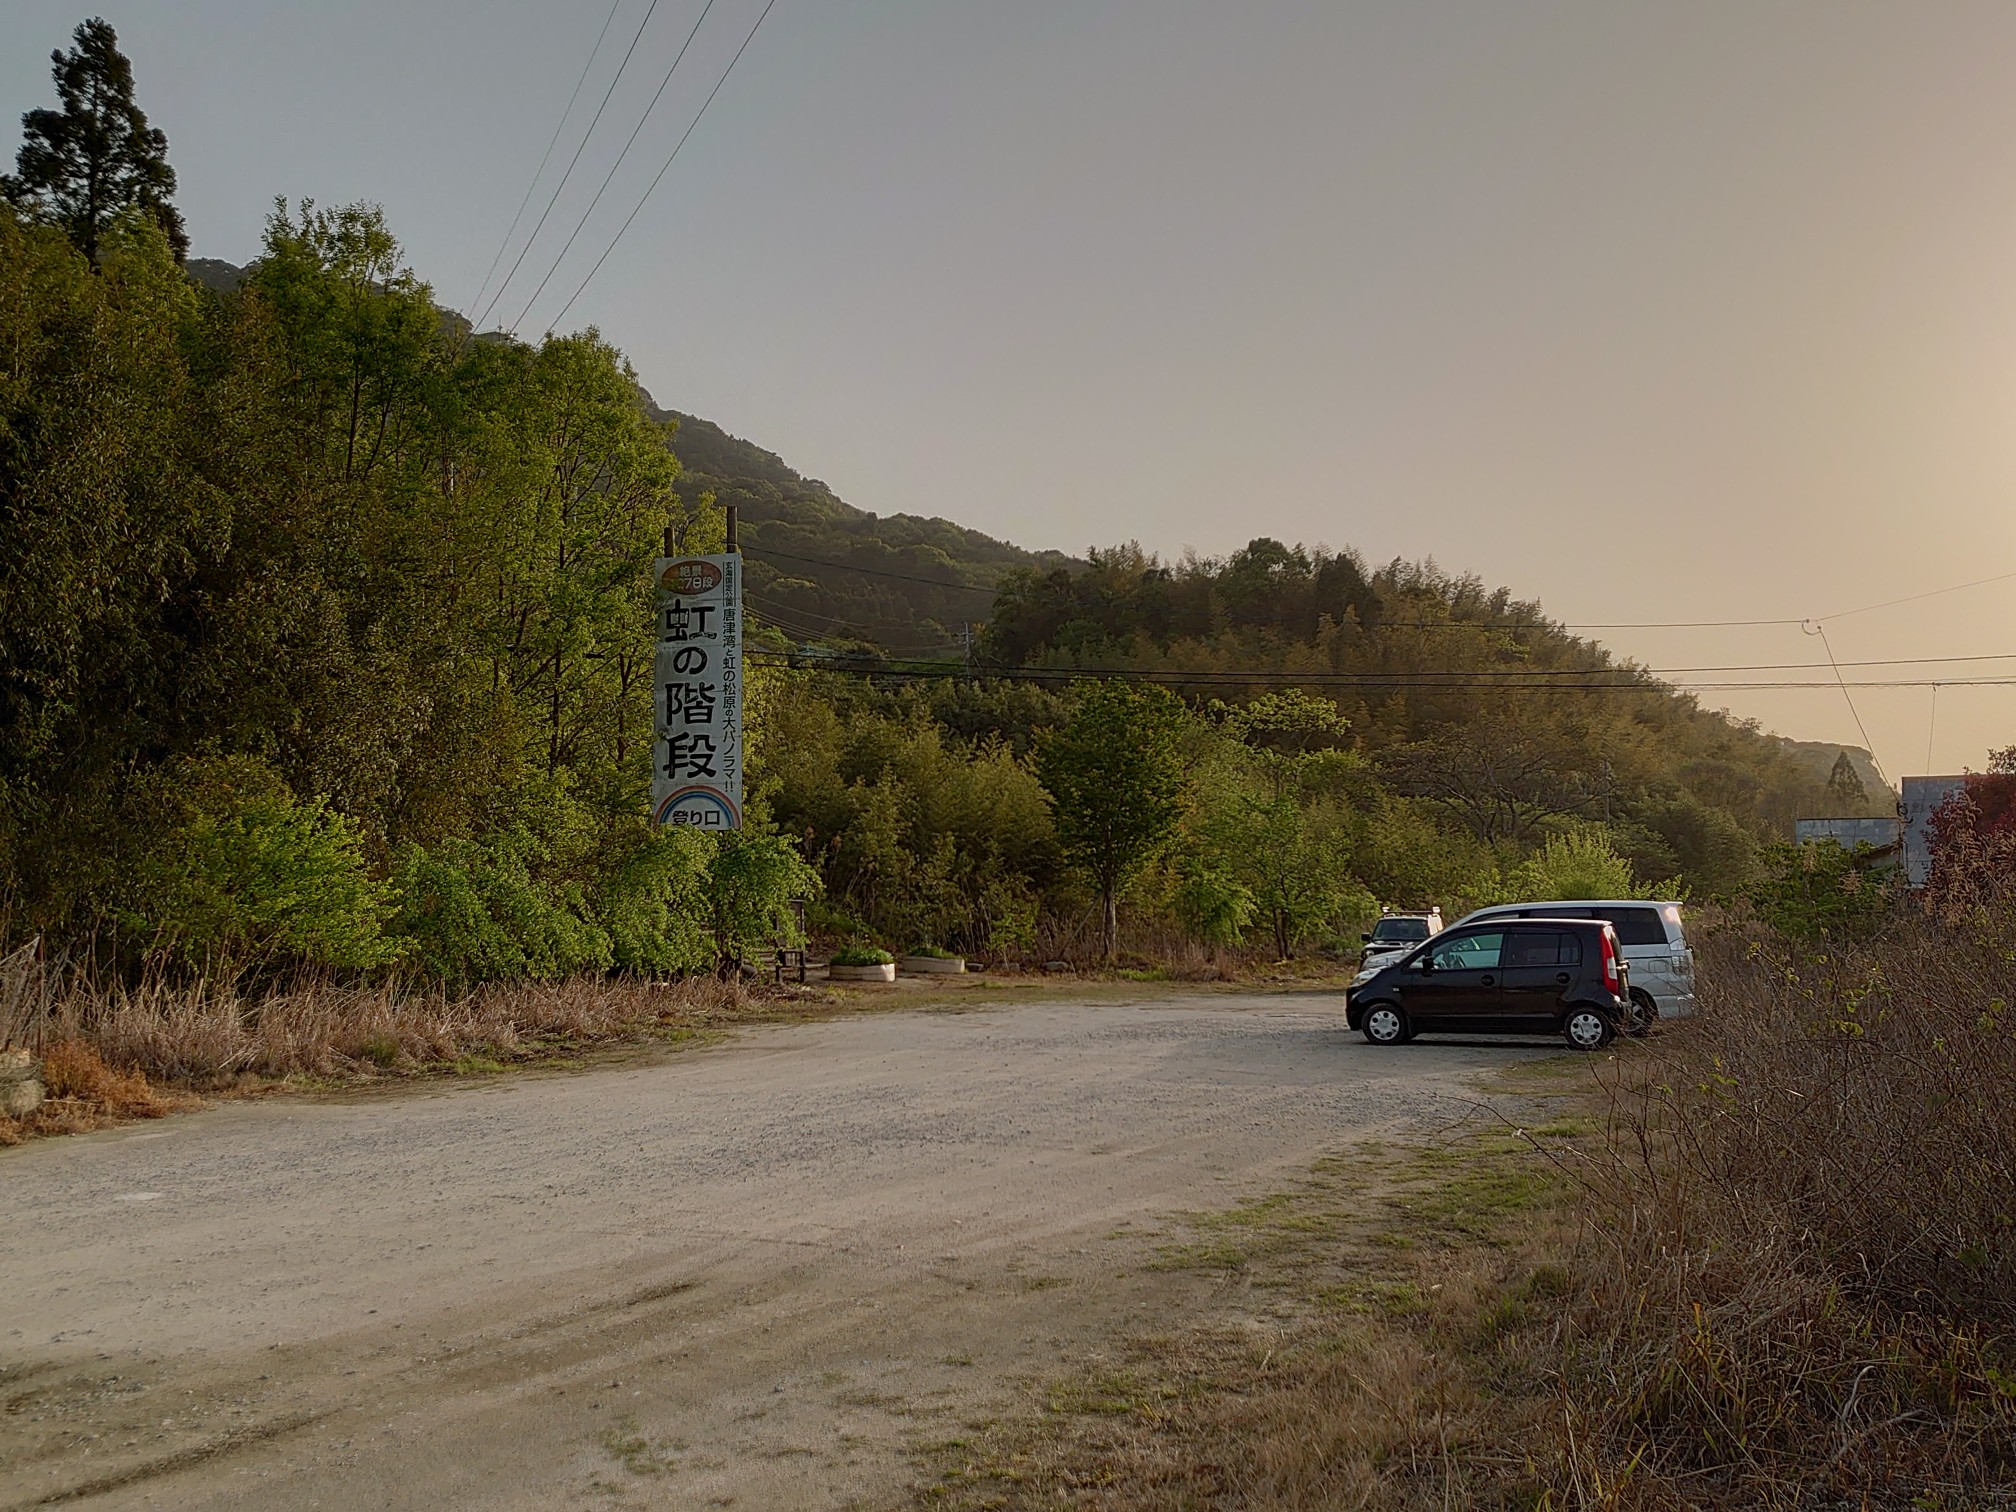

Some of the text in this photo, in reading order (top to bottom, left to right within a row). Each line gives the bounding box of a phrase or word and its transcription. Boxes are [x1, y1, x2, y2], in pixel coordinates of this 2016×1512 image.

[663, 598, 717, 779] 虹の階段
[672, 810, 720, 826] 登り口
